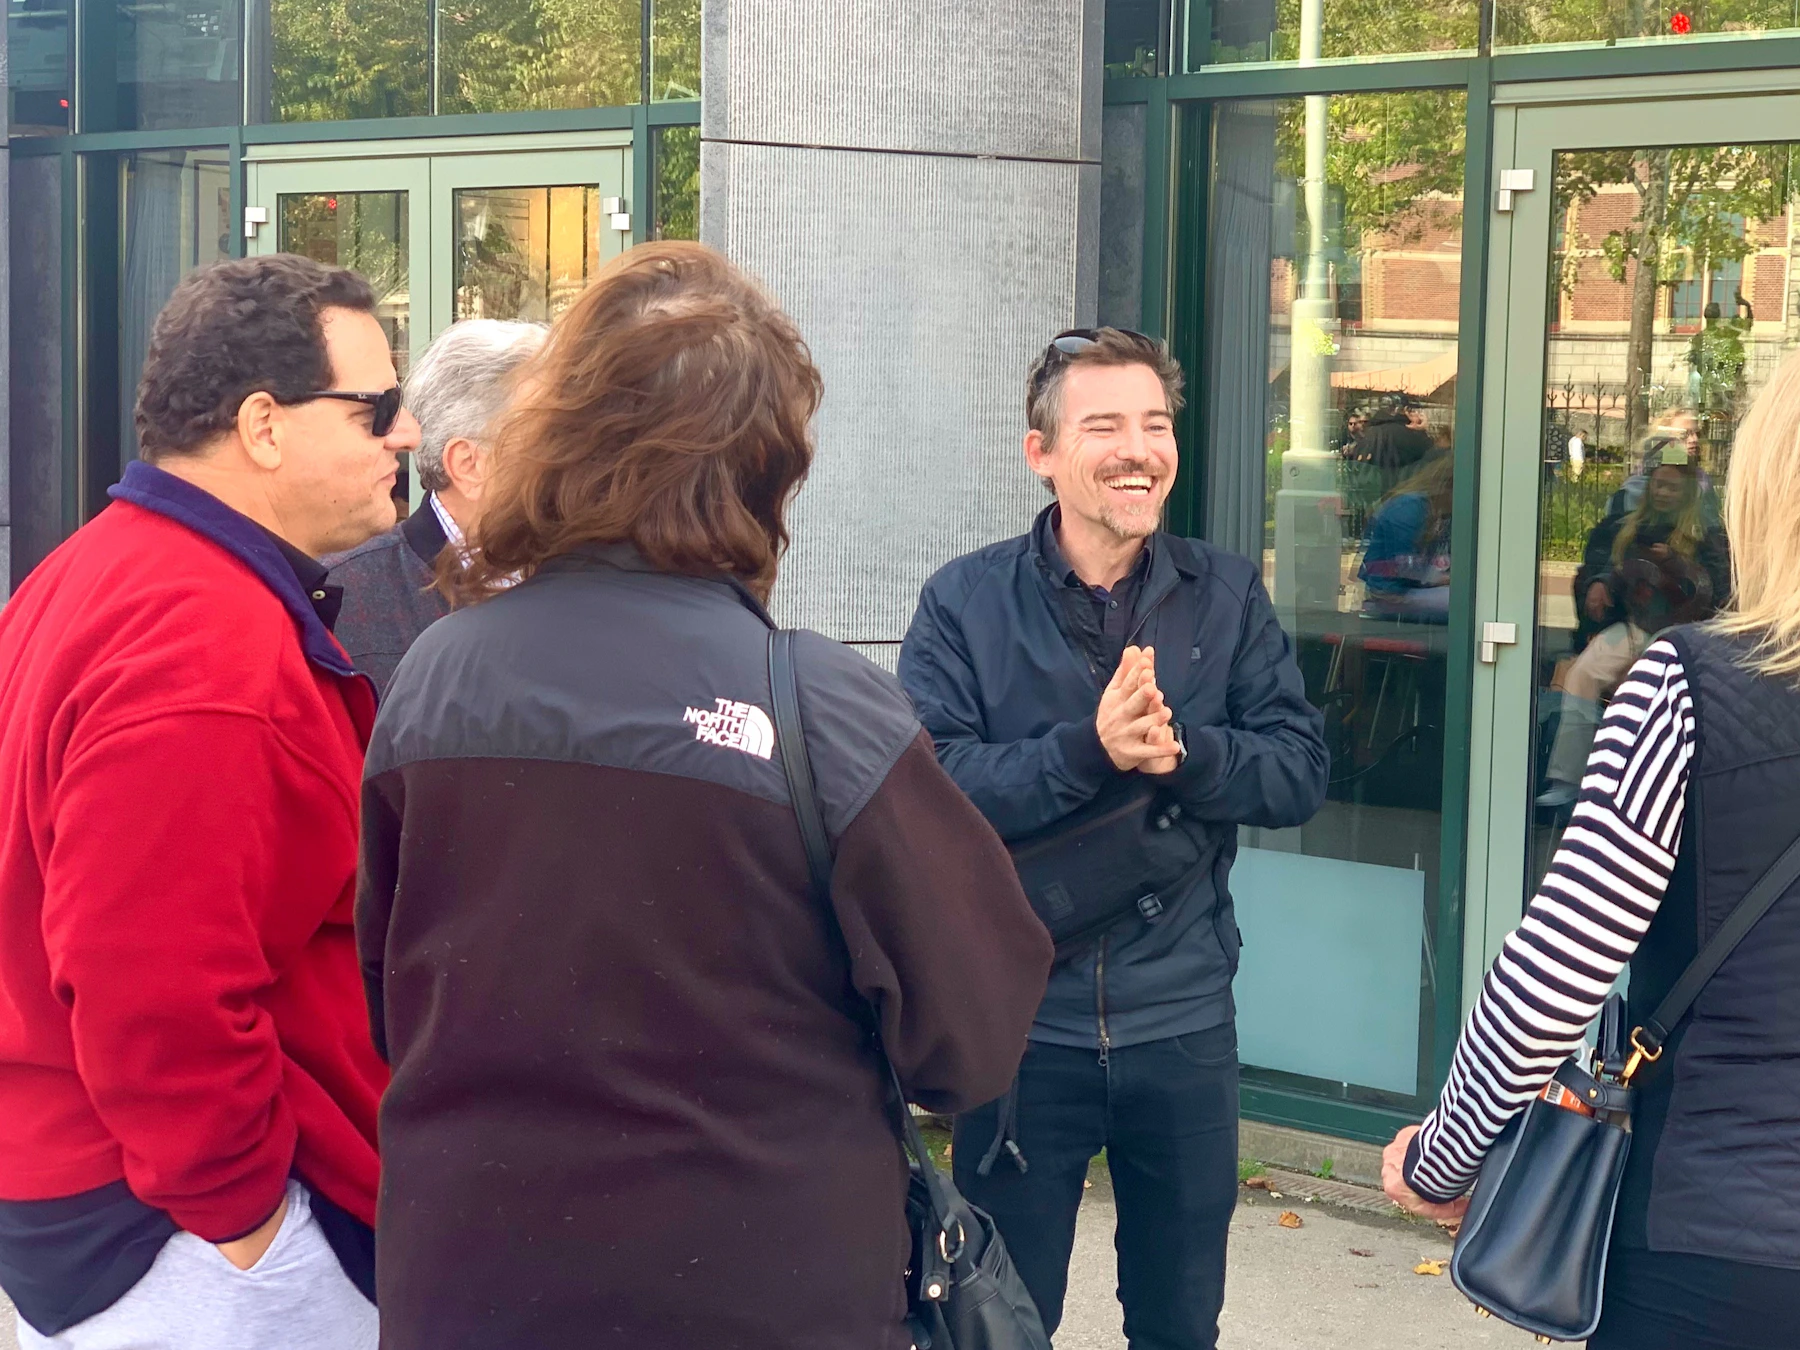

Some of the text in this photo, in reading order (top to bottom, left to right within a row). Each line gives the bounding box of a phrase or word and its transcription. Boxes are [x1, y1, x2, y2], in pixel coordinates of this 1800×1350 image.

[715, 697, 750, 718] THE
[683, 706, 745, 734] NORTH
[696, 724, 742, 748] FACE
